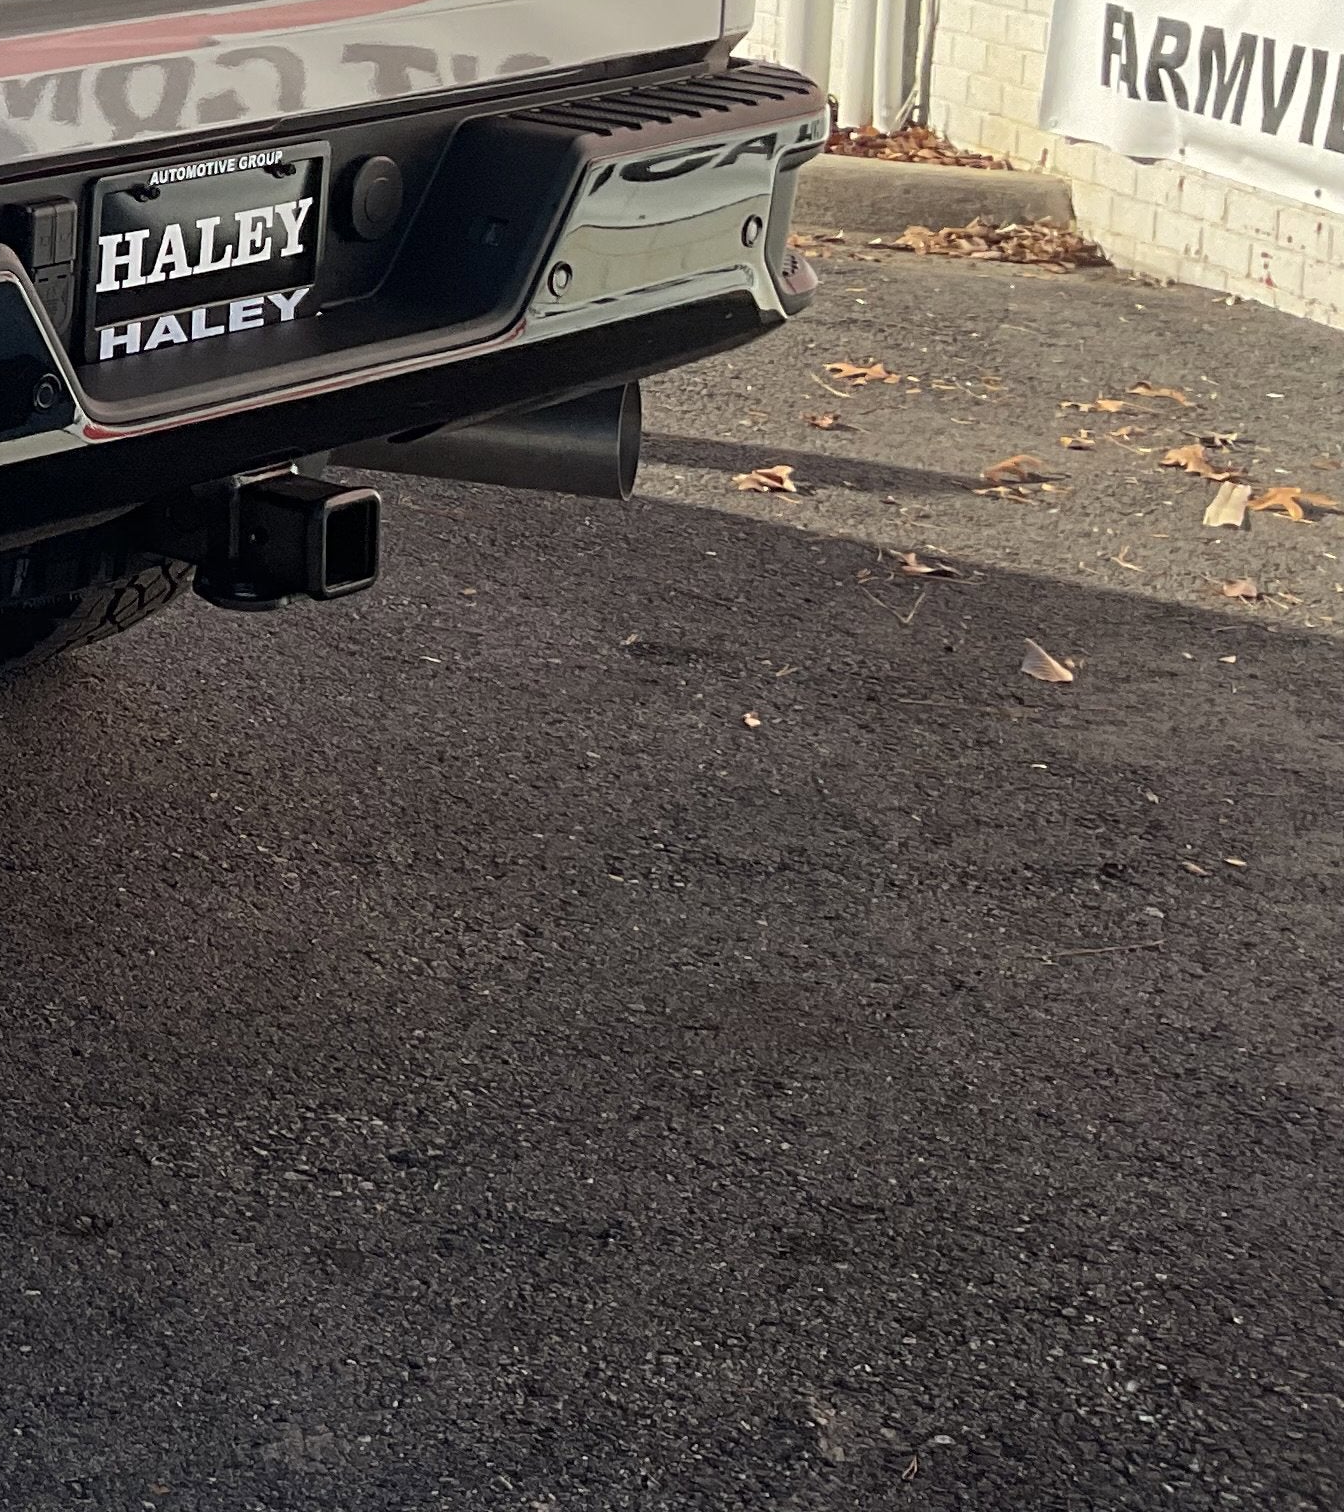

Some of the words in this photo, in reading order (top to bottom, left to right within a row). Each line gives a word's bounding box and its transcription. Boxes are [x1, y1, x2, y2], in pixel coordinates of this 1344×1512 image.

[149, 157, 236, 186] AUTOMOTIVE
[238, 150, 283, 171] GROUP
[96, 196, 313, 293] HALEY
[99, 287, 310, 360] HALEY
